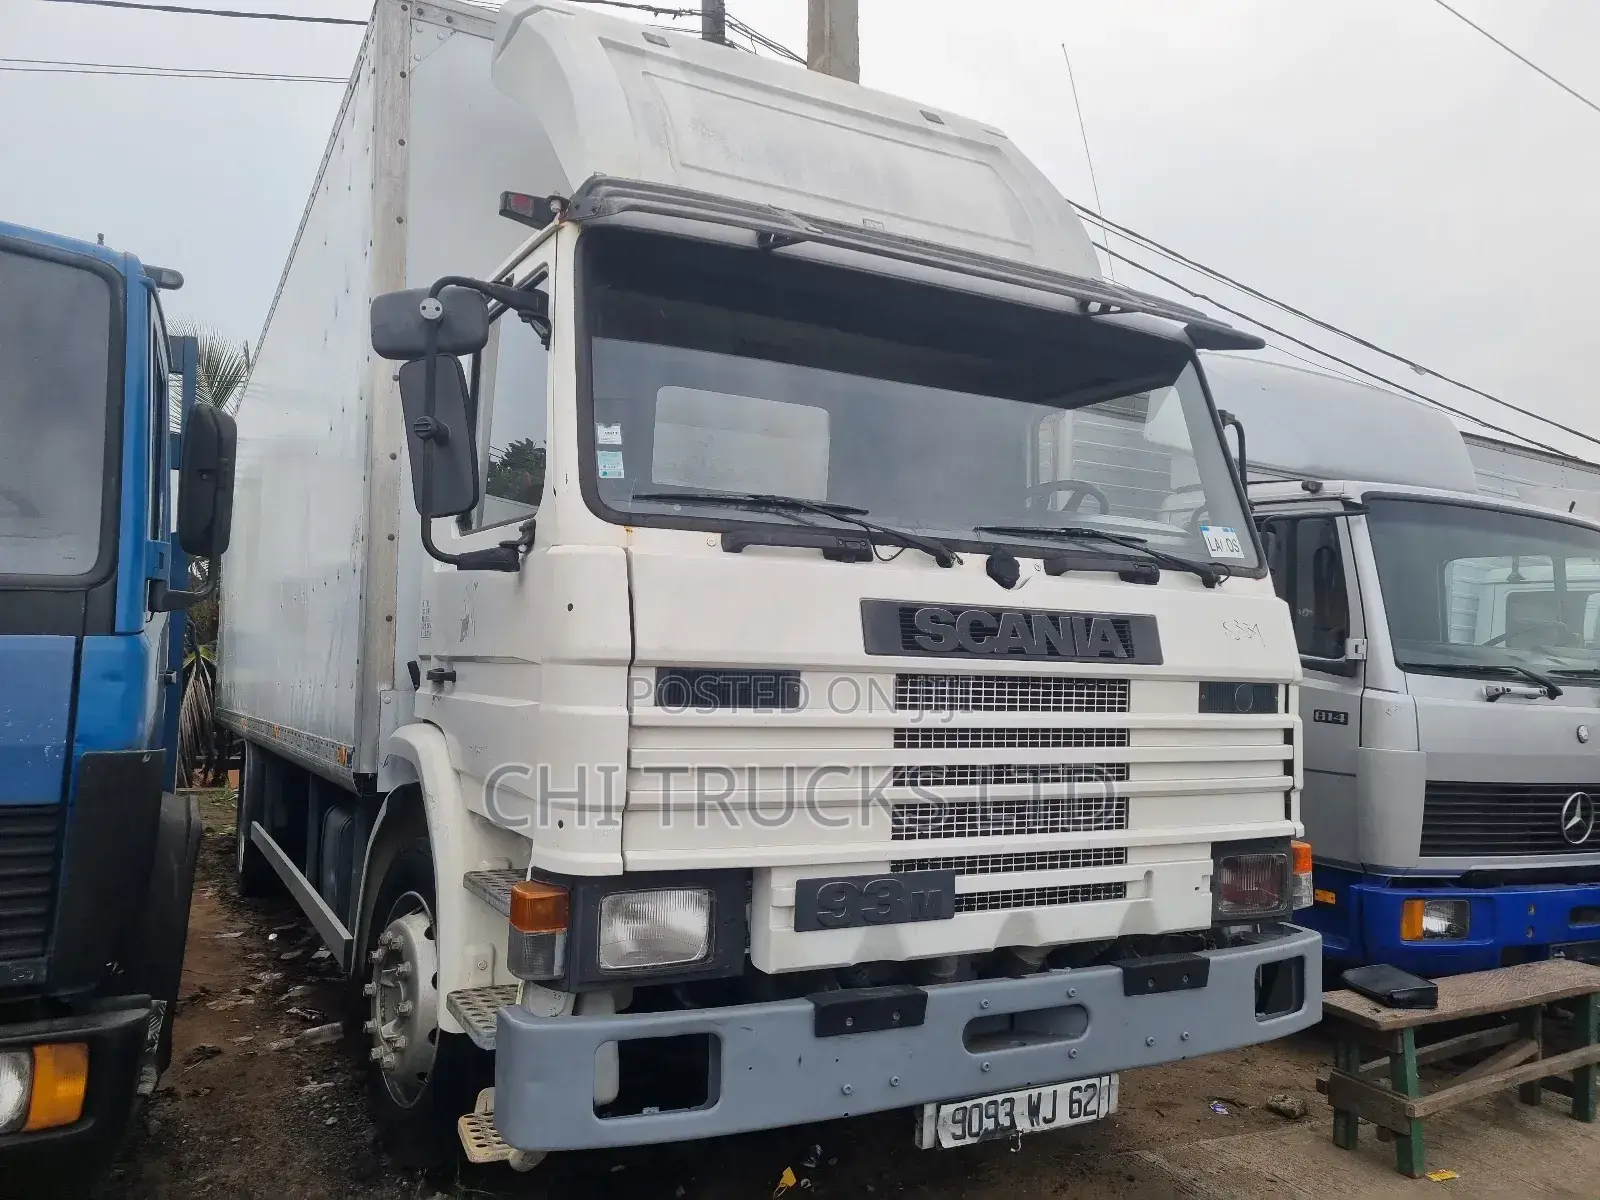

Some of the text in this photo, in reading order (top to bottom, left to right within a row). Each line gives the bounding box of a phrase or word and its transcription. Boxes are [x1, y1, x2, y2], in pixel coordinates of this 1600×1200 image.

[1207, 537, 1240, 553] LAOS
[914, 607, 1128, 658] SCANIA
[1315, 711, 1345, 723] 814
[951, 1082, 1098, 1140] 9093 WJ 62
